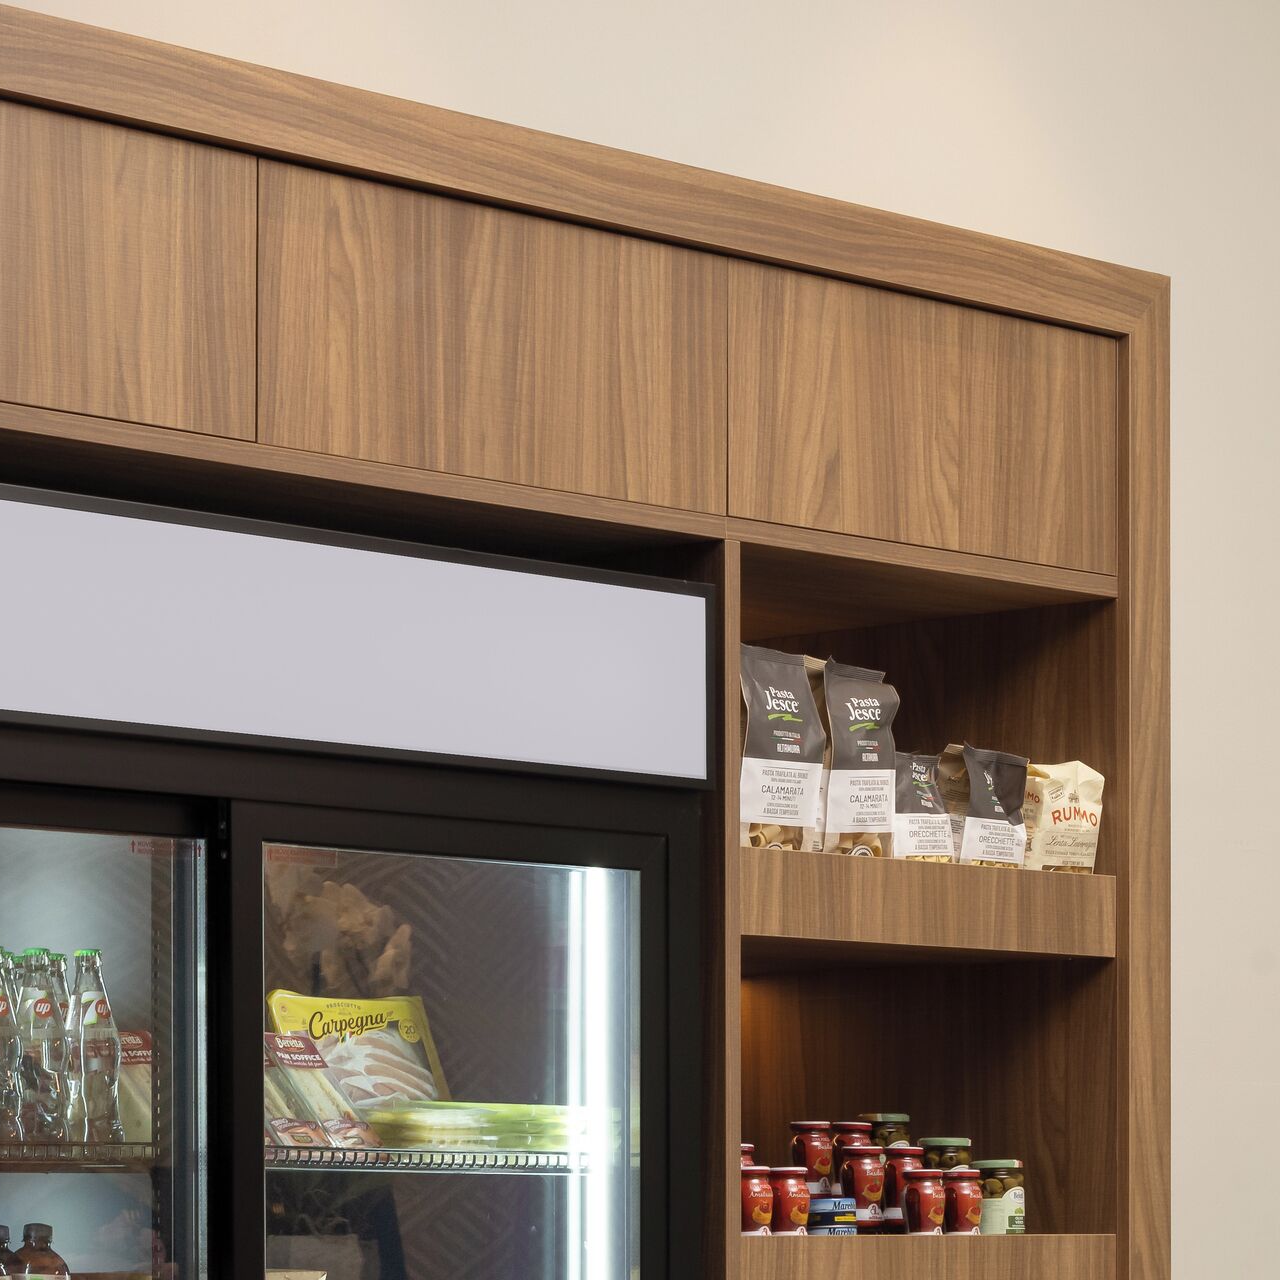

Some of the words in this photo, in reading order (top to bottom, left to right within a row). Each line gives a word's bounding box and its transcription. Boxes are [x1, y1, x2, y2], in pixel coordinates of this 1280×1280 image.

[768, 686, 796, 700] Pasta
[764, 689, 800, 713] Jesce
[850, 697, 880, 708] Pasta
[844, 702, 882, 721] Jesce
[761, 784, 804, 796] CALAMARATA
[849, 794, 889, 804] CALAMARATA
[1051, 805, 1099, 828] RUMMO
[908, 830, 948, 839] ORECCHIETTE
[35, 1002, 51, 1016] up
[308, 1010, 387, 1041] Carpegna
[403, 1024, 417, 1035] 20
[275, 1036, 305, 1049] Beretta
